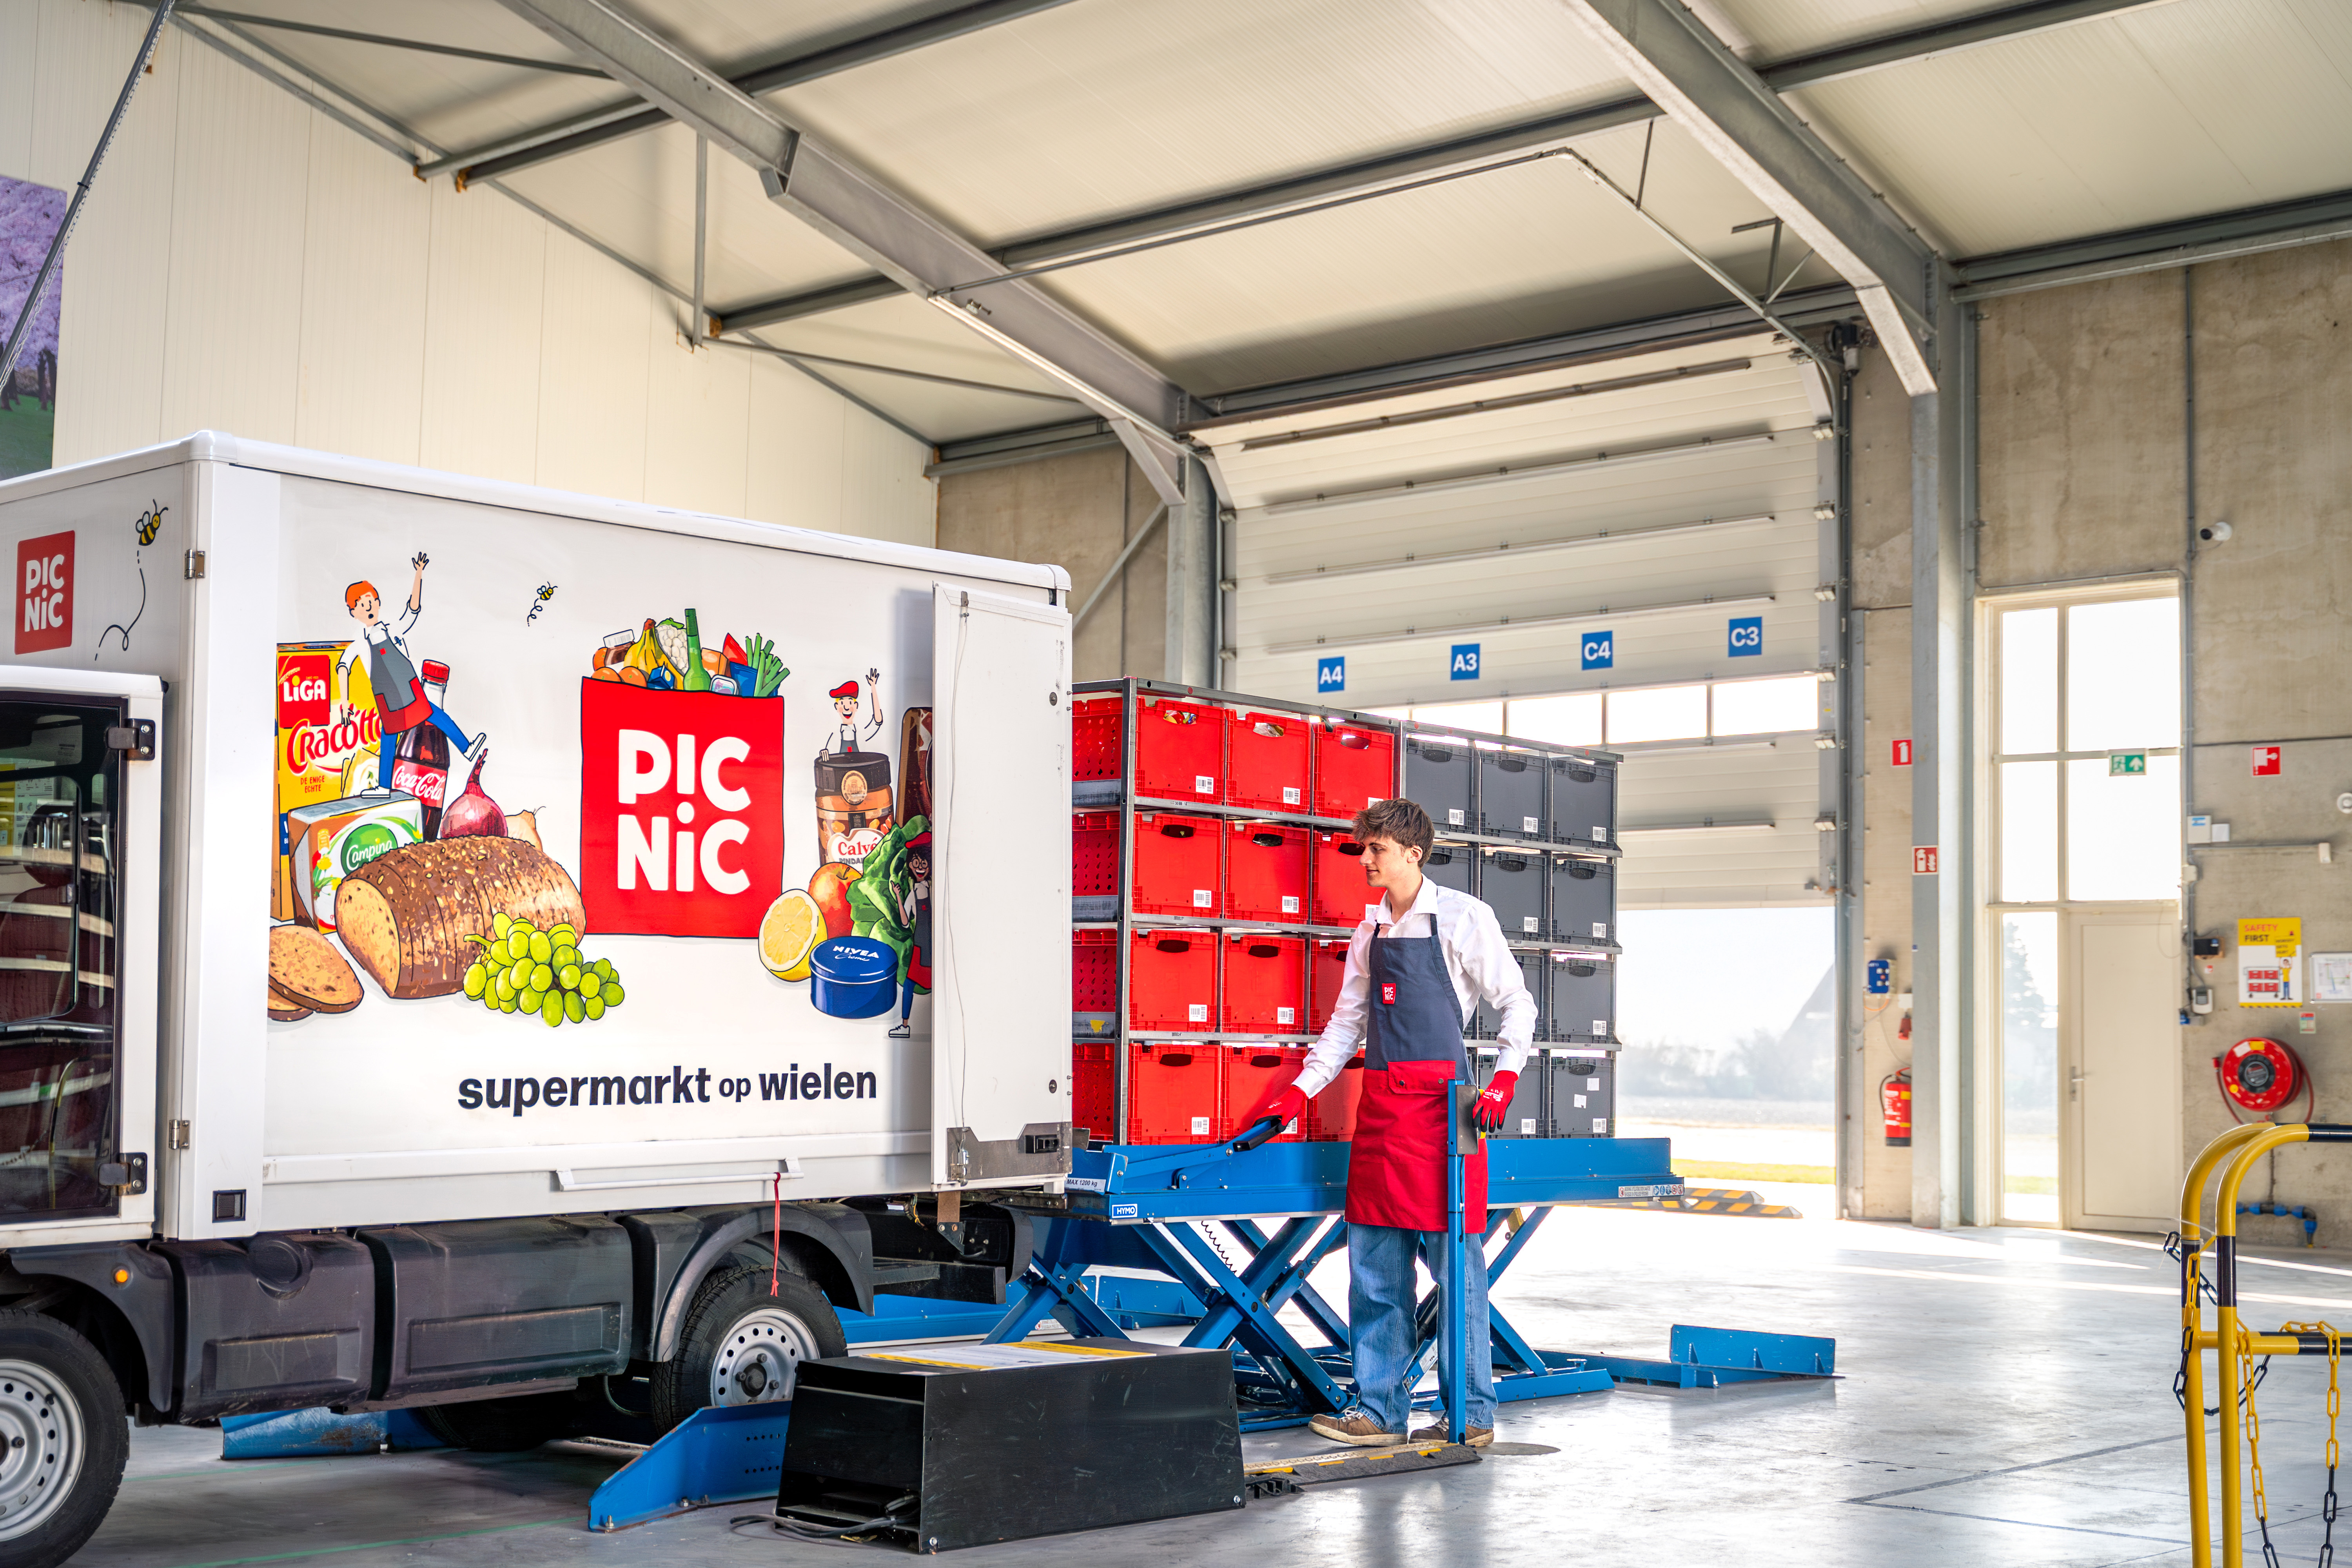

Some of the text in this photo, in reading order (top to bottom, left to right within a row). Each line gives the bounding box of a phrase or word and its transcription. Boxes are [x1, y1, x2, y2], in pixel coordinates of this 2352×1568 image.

[25, 554, 65, 594] PIC
[1731, 627, 1759, 647] C3
[1584, 641, 1611, 661] C4
[1453, 654, 1477, 671] A3
[1319, 666, 1343, 684] A4
[310, 775, 325, 784] ENIGE
[619, 729, 751, 812] PIC
[305, 784, 321, 793] ECHTE
[394, 765, 446, 800] Coca-Cola
[346, 838, 393, 871] Campina
[838, 837, 877, 855] Calvé
[2244, 924, 2278, 932] SAFETY
[833, 946, 879, 958] NIVEA
[457, 1063, 877, 1117] supermarkt op wielen
